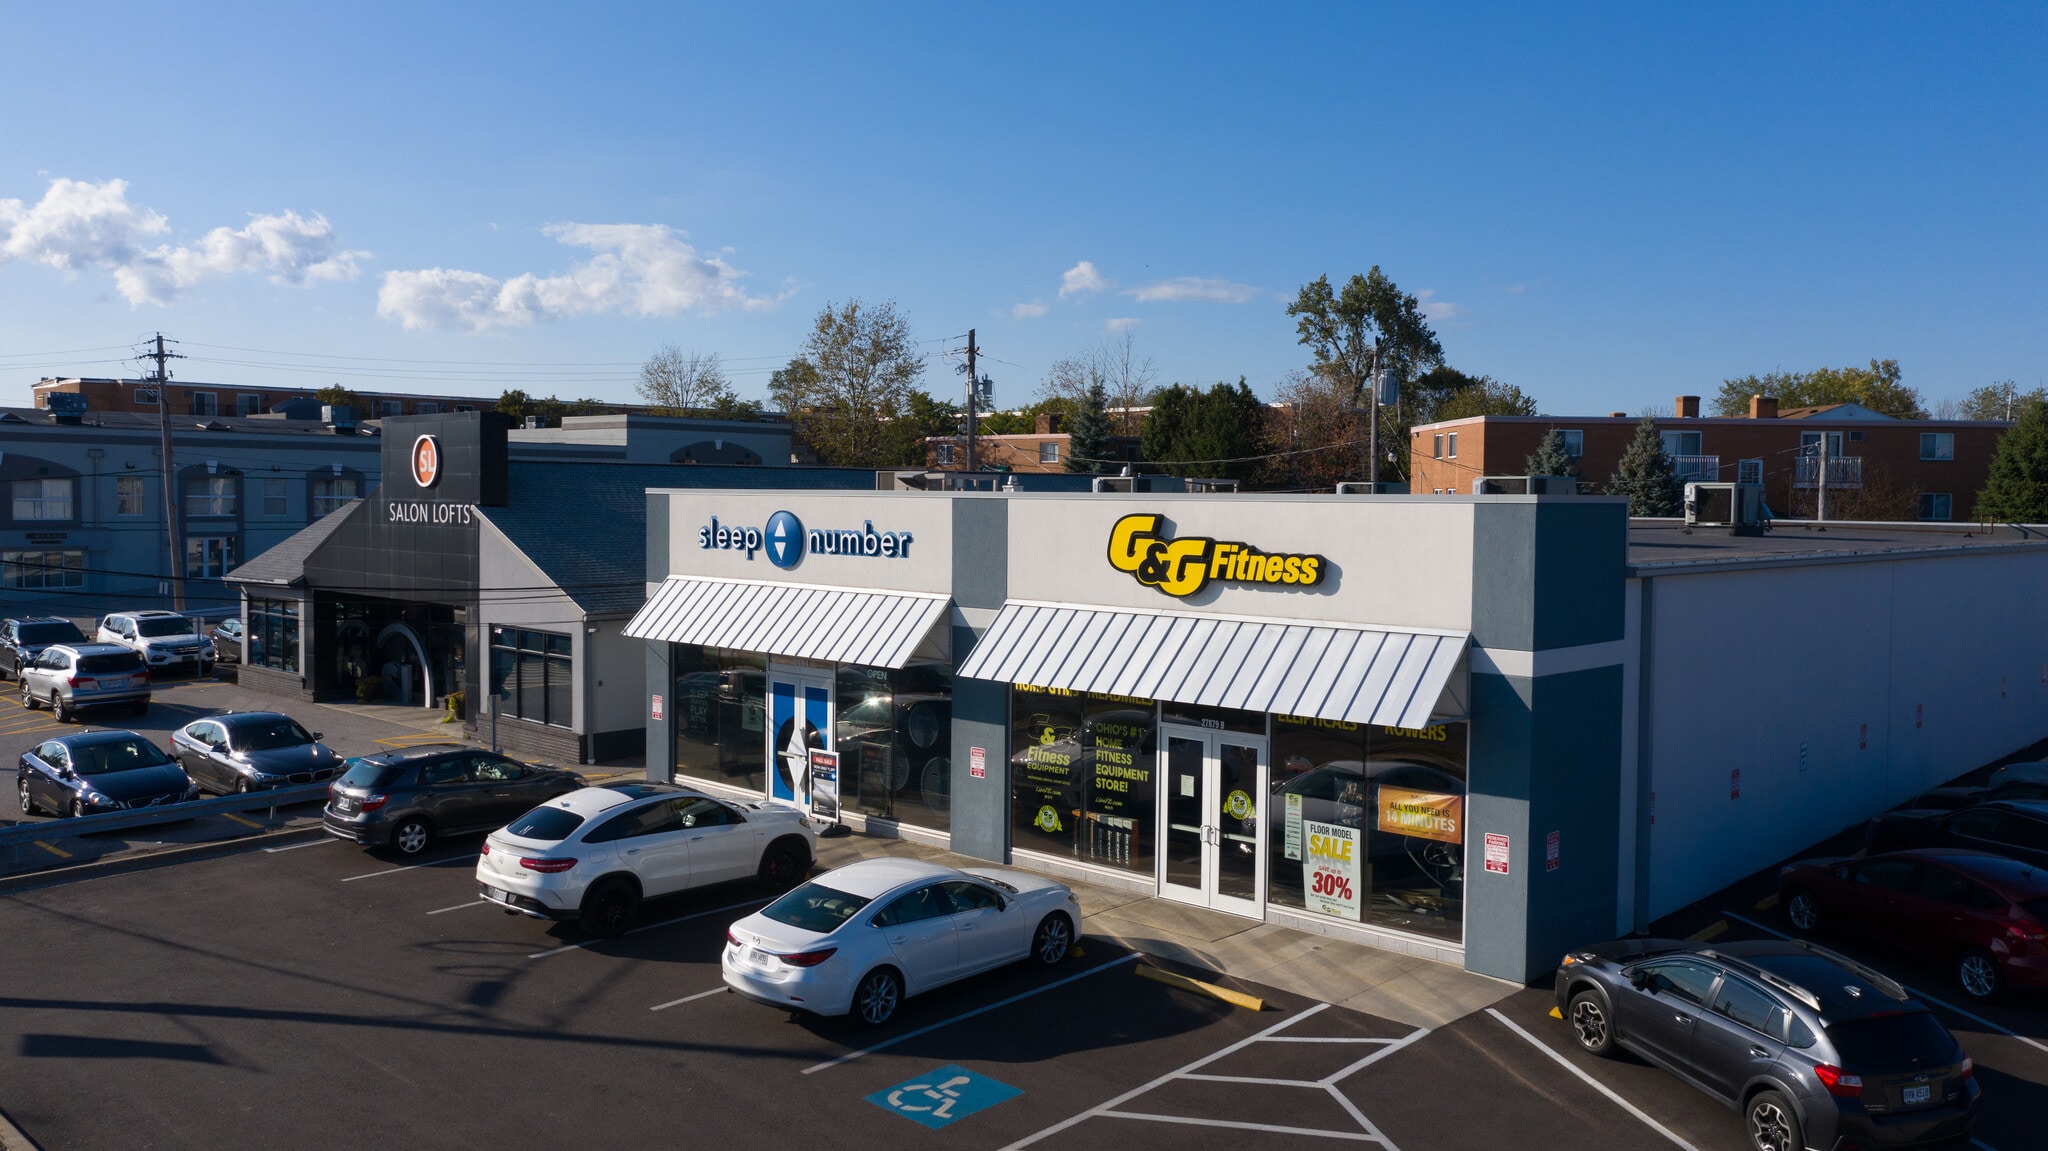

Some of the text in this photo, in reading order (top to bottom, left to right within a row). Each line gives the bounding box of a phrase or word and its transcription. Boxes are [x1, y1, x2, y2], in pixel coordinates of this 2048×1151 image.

[420, 450, 434, 472] SL
[390, 503, 470, 524] SALON LOFTS
[698, 516, 914, 560] sleep number
[1107, 514, 1323, 597] G&G Fitness
[867, 669, 888, 680] OPEN
[1096, 722, 1128, 737] OHIO'S
[1096, 736, 1123, 750] HOME
[1027, 745, 1071, 766] Fitness
[1096, 750, 1132, 765] FITNESS
[1026, 763, 1070, 775] EQUIPMENT
[1096, 764, 1149, 782] EQUIPMENT
[1096, 778, 1128, 792] STORE!
[1390, 802, 1450, 818] ALL YOU NEED IS
[1386, 810, 1398, 822] 14
[1400, 812, 1455, 832] MINUTES
[1310, 824, 1352, 840] FLOOR MODEL
[1309, 834, 1352, 862] SALE
[1312, 871, 1352, 900] 30%
